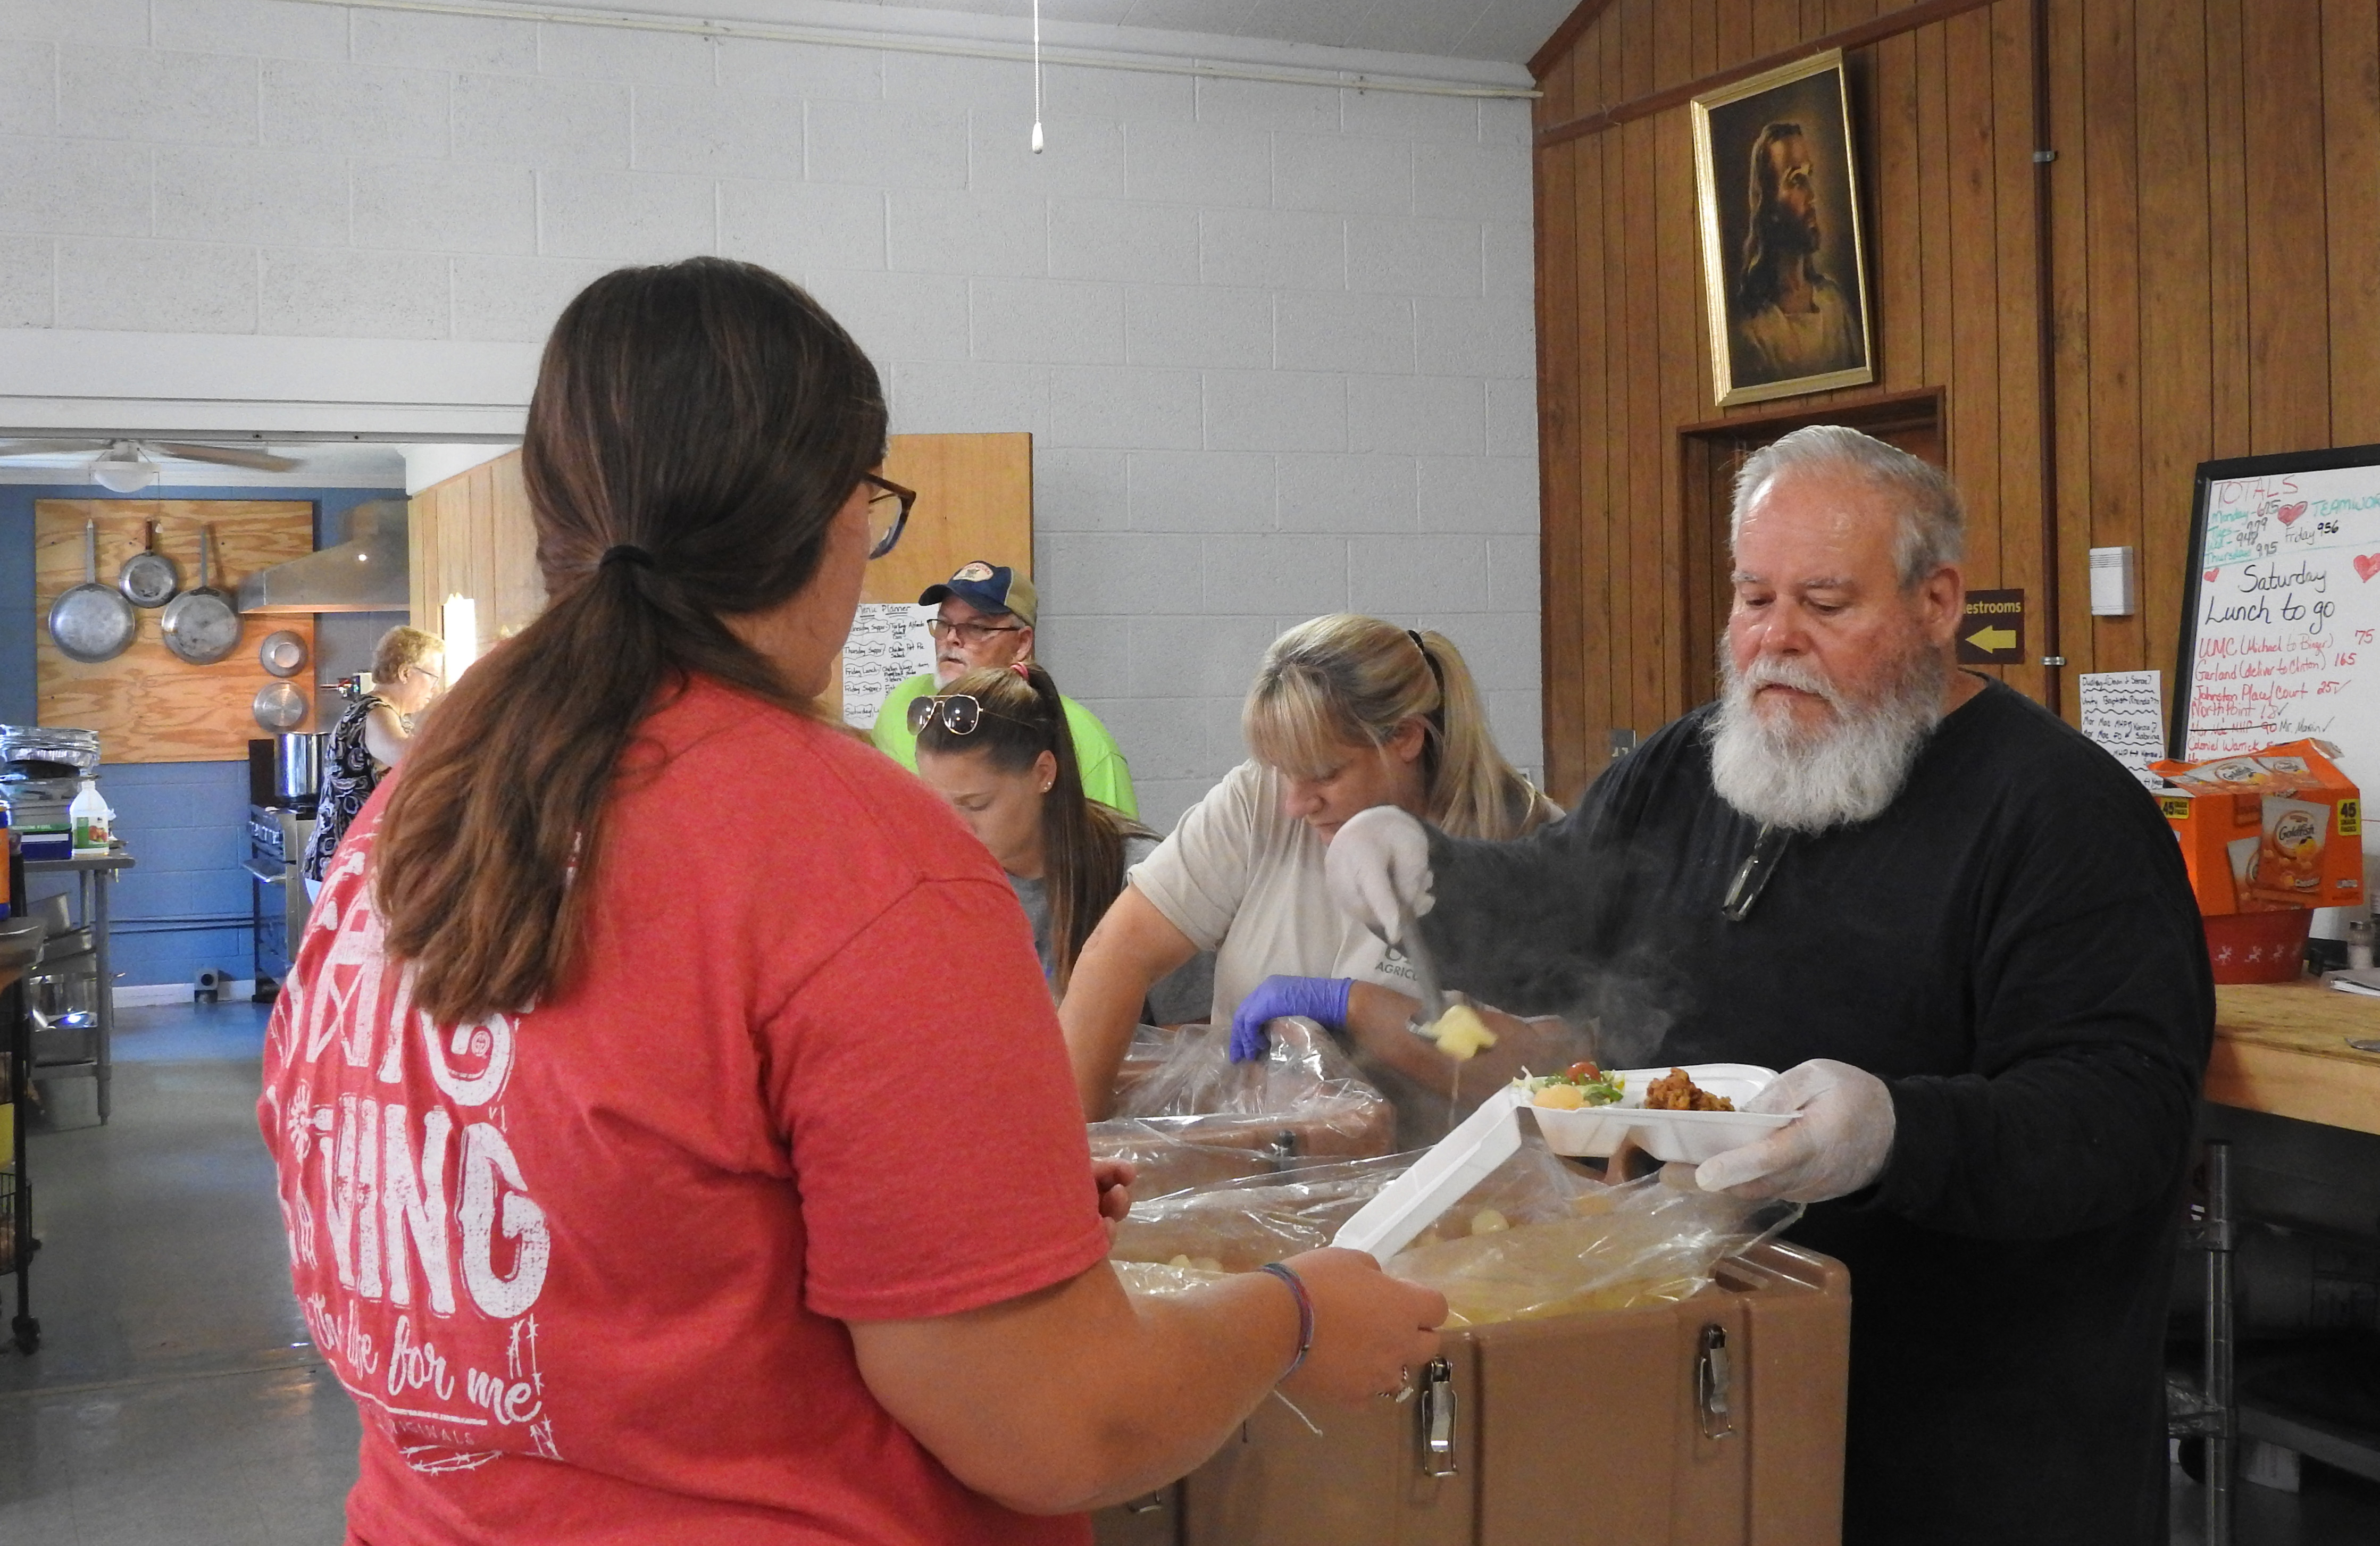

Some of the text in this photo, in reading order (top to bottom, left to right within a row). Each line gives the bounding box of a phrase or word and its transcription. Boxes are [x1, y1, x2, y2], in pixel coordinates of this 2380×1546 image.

[2214, 474, 2298, 509] TOTALS
[2317, 519, 2339, 537] 956
[2238, 561, 2327, 593] Saturday
[1964, 601, 2021, 614] estrooms
[2206, 592, 2335, 634] Lunch to go
[2354, 628, 2375, 645] 75
[2199, 637, 2237, 658] UMC
[2334, 653, 2357, 667] 165
[845, 667, 862, 678] Friday
[844, 685, 860, 694] Friday
[2341, 802, 2357, 818] 45
[2278, 823, 2315, 841] Goldfish
[387, 1315, 455, 1401] for
[467, 1367, 542, 1426] me
